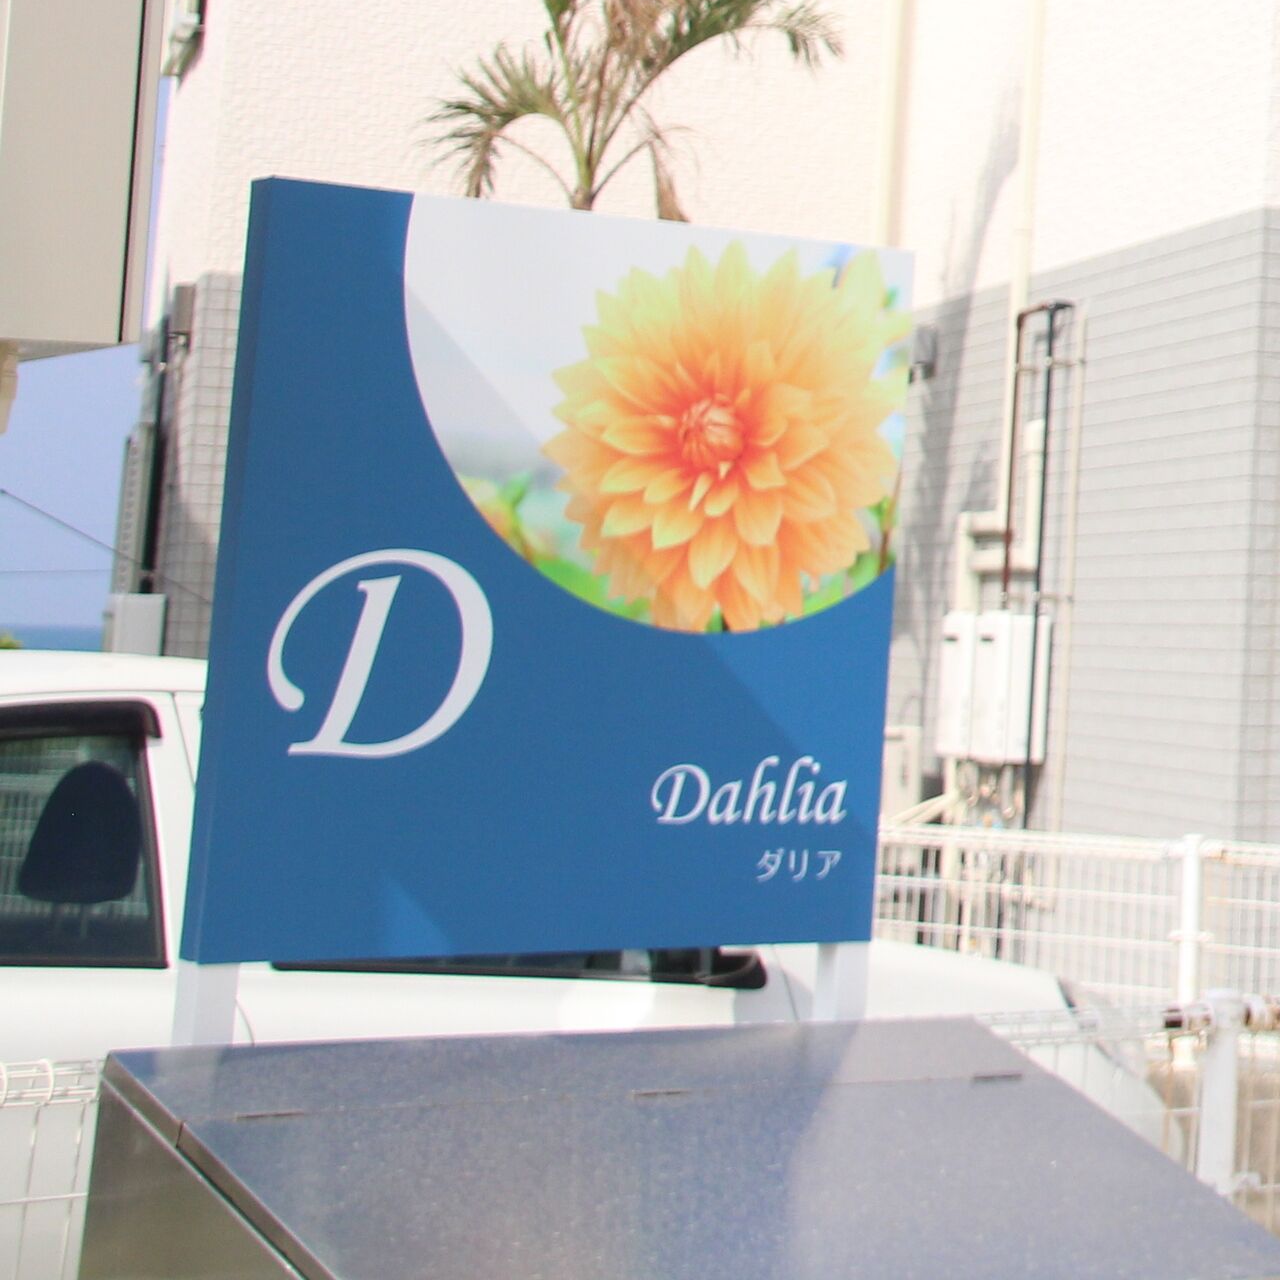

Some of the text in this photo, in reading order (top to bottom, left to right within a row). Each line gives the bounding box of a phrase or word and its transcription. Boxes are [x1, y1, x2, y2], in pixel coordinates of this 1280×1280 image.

[266, 548, 494, 759] D
[651, 755, 848, 825] Dahlia
[756, 846, 842, 883] ダリア
